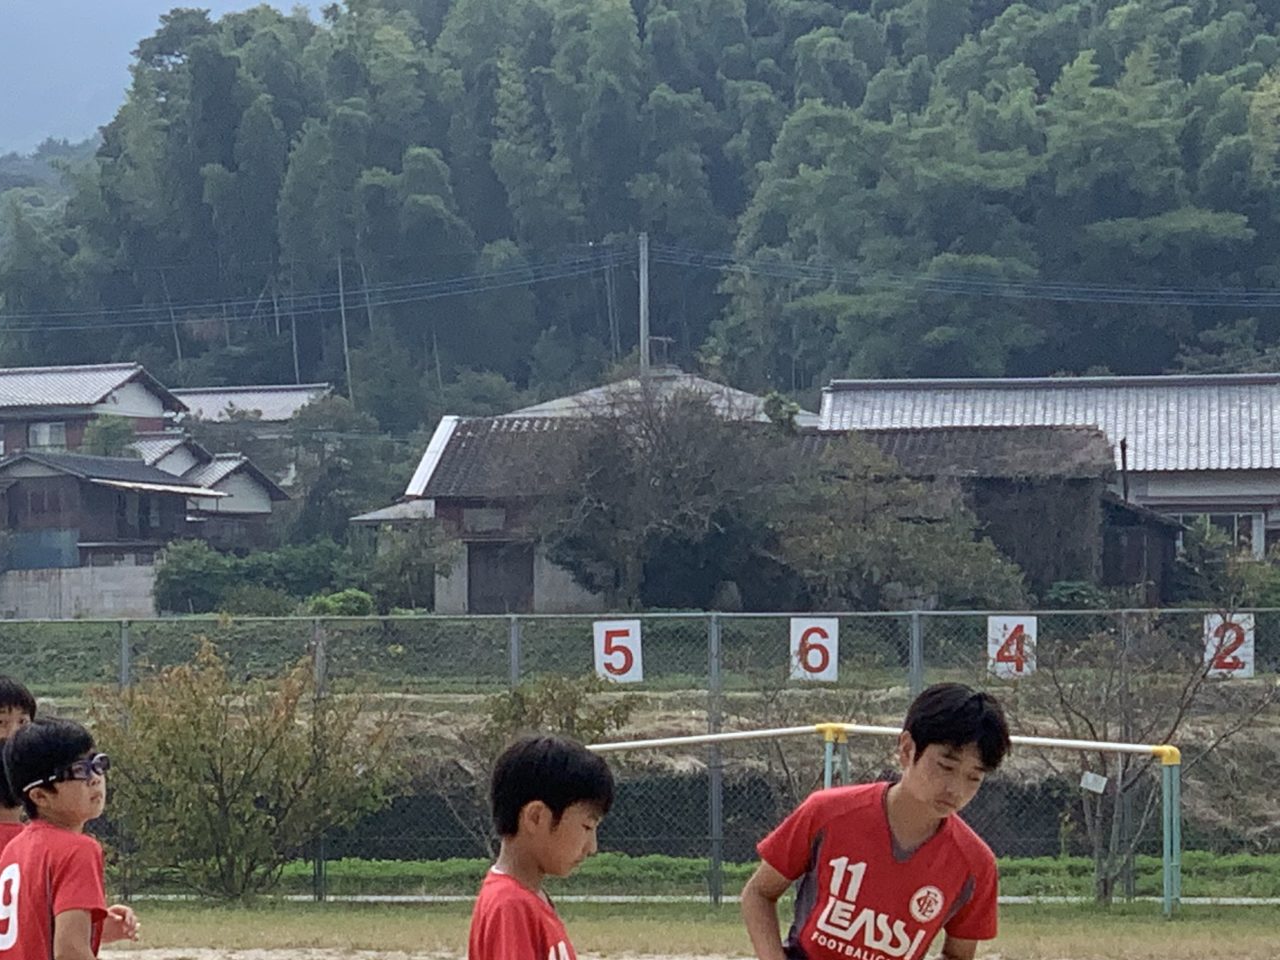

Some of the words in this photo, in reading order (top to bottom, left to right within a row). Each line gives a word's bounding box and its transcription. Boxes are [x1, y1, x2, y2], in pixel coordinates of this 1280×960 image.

[603, 629, 634, 675] 5
[800, 626, 830, 673] 6
[996, 624, 1024, 672] 4
[1214, 622, 1246, 670] 2
[829, 856, 867, 902] 11
